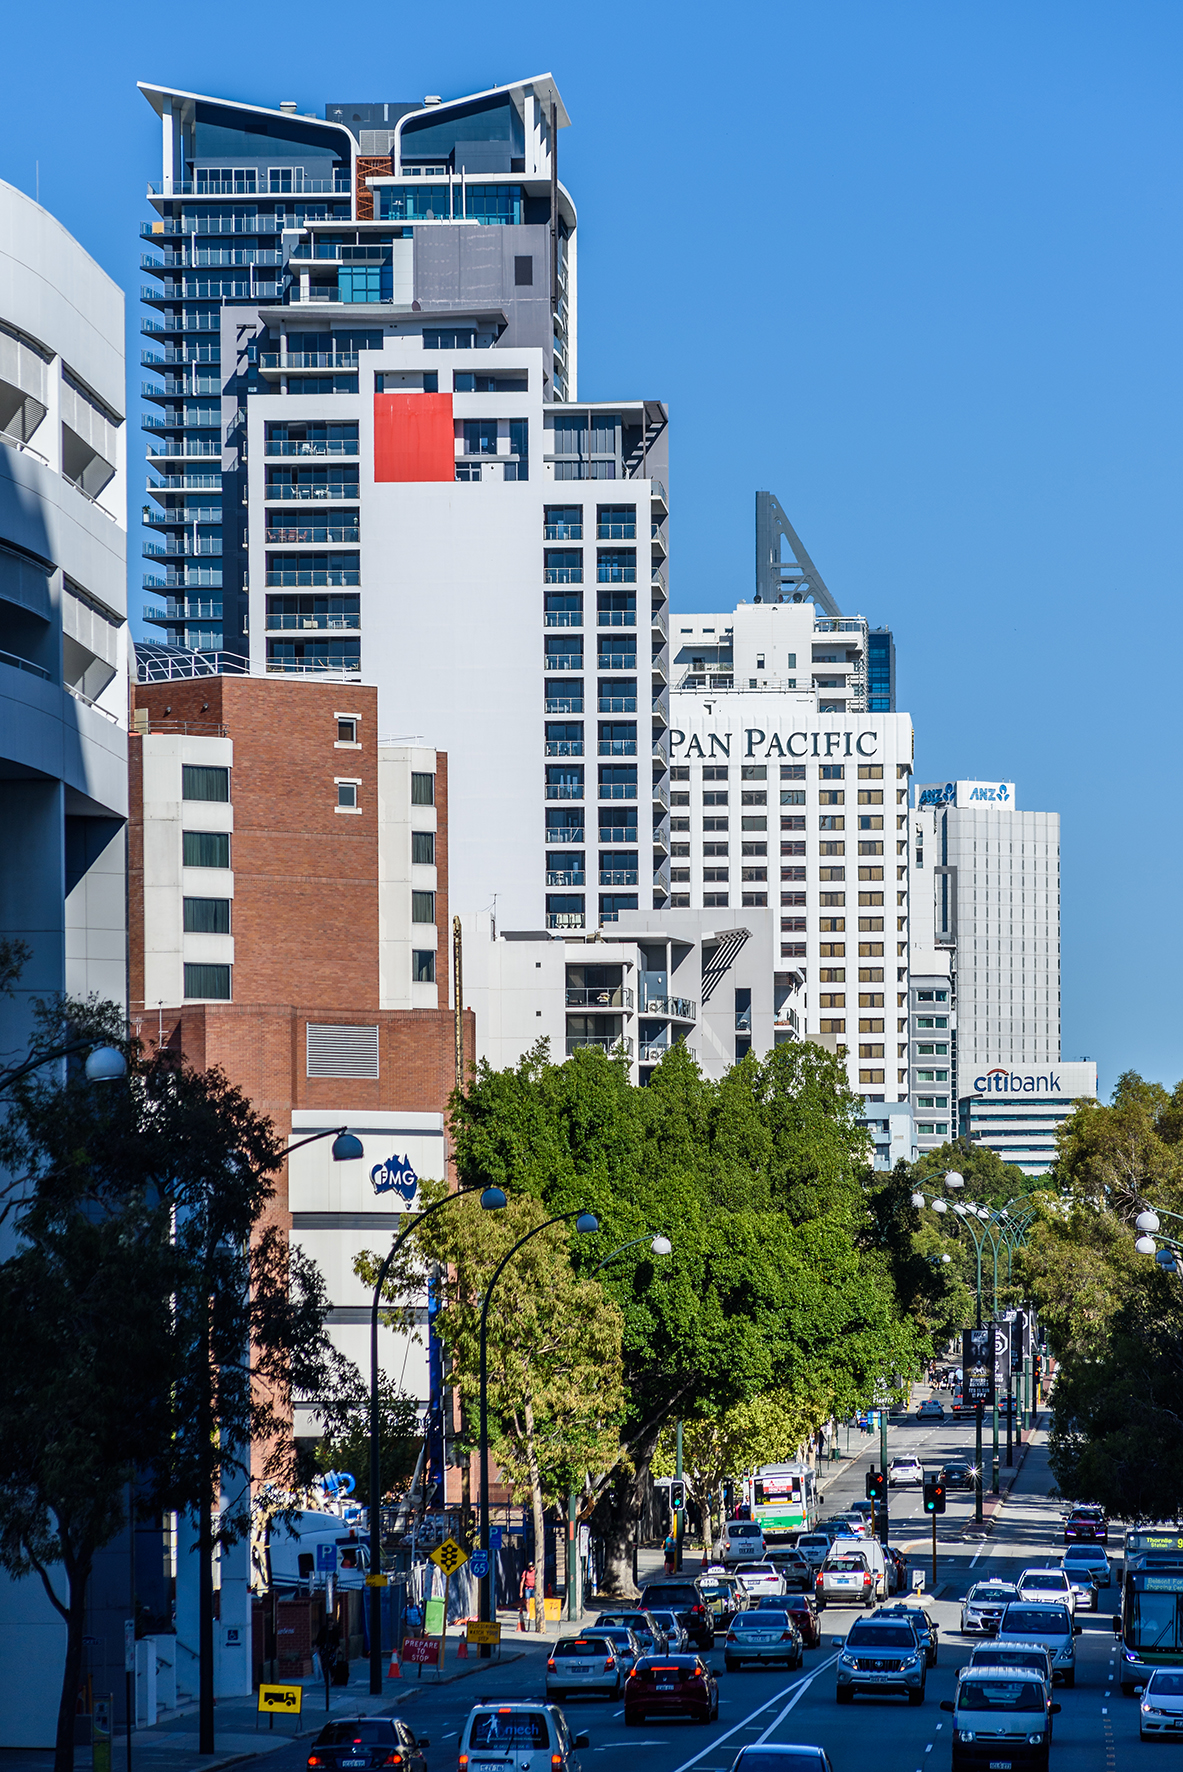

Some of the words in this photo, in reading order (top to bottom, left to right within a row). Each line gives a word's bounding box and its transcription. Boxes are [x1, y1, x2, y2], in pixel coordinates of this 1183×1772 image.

[669, 729, 733, 758] PAN
[744, 729, 878, 758] PACIFIC
[919, 788, 943, 805] ANZ
[969, 787, 996, 801] ANZ
[973, 1068, 1061, 1092] citibank
[381, 1170, 415, 1186] FMG
[490, 1527, 499, 1539] P
[322, 1545, 332, 1559] P
[473, 1563, 486, 1574] 65
[404, 1639, 438, 1649] PREPARE
[411, 1654, 430, 1662] STOP
